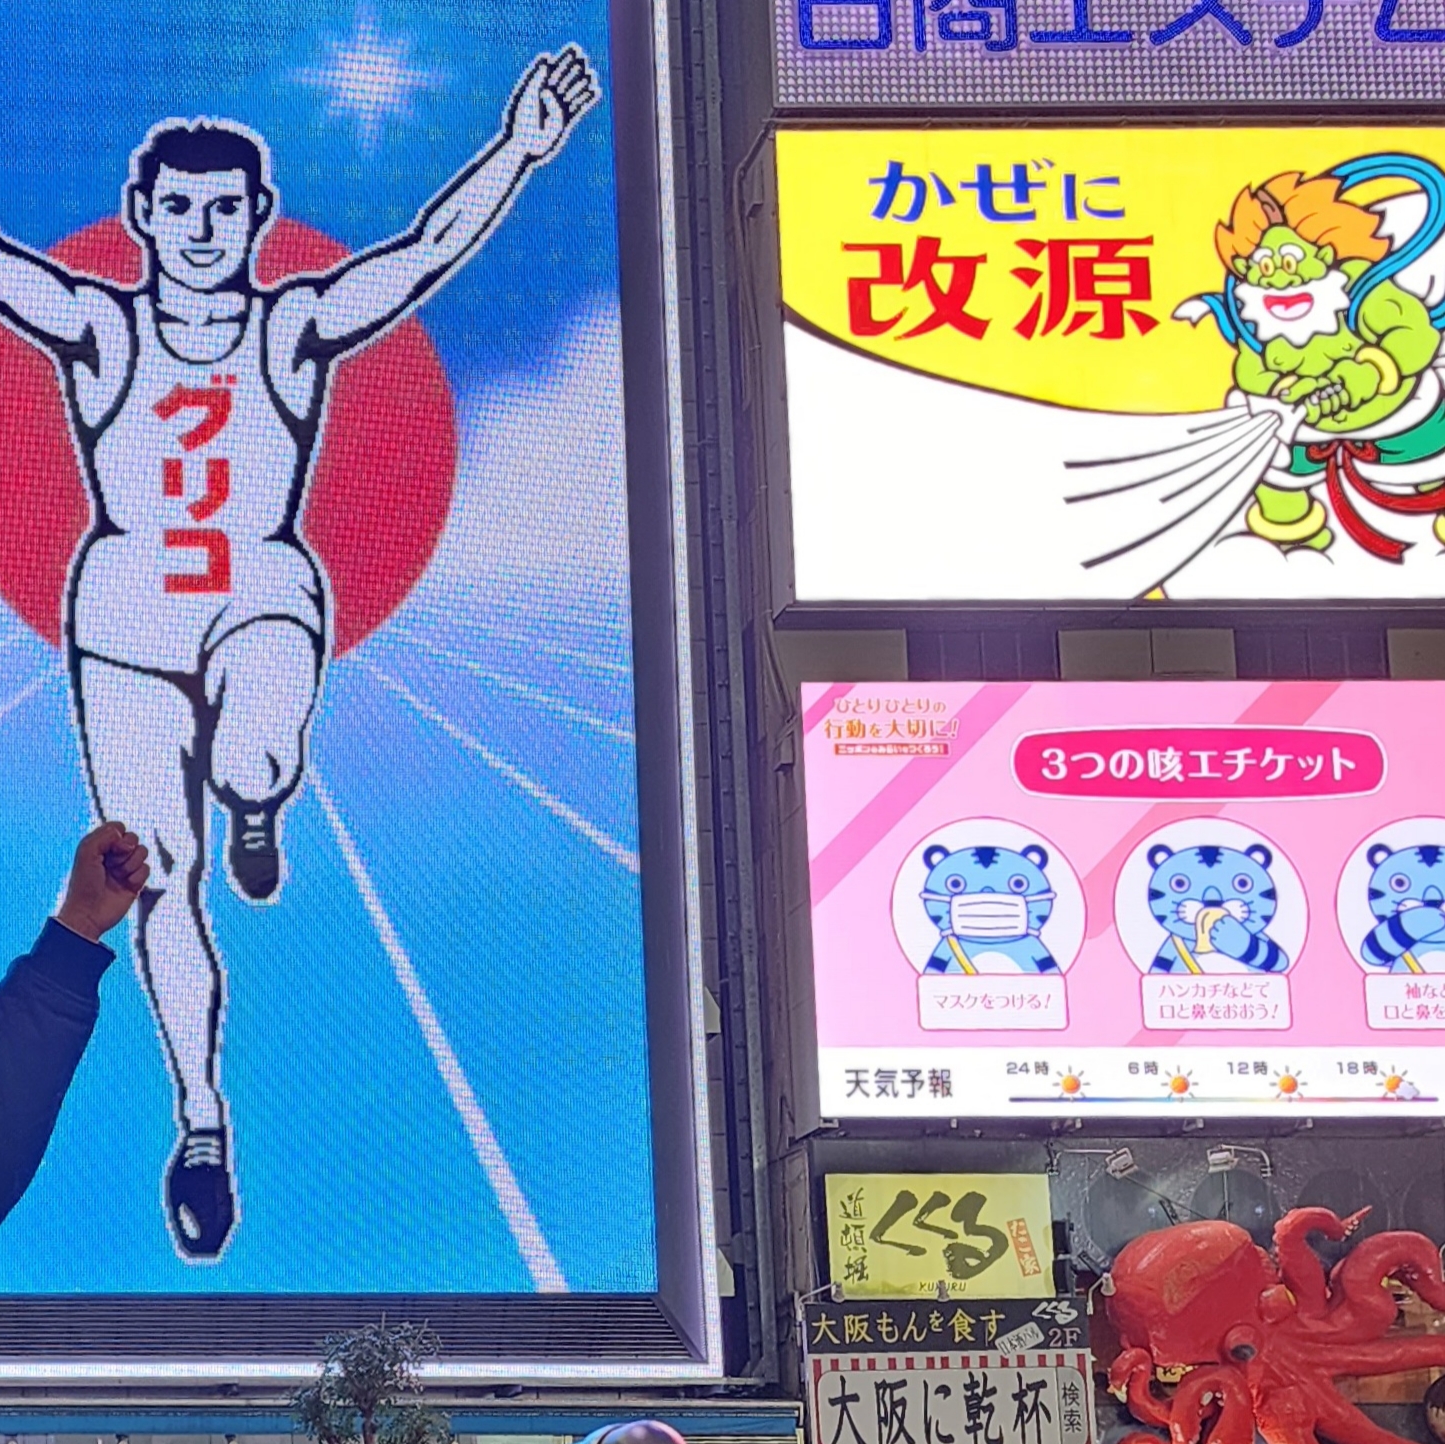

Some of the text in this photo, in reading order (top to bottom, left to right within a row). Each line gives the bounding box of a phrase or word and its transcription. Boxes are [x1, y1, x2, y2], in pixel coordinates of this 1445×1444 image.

[868, 158, 1126, 223] かぜに
[841, 234, 1161, 341] 改源
[154, 373, 237, 594] グリコ
[836, 698, 946, 714] ひとりひとりの
[1041, 746, 1356, 783] 3つの咳エチケット
[933, 993, 1052, 1010] マスクをつける!
[1158, 981, 1271, 999] ハンカチなどで
[1159, 1003, 1279, 1020] 口と鼻をおおう!
[1006, 1061, 1049, 1076] 24時
[1128, 1061, 1158, 1075] 6時
[1227, 1061, 1268, 1075] 12時
[1337, 1060, 1378, 1075] 18時
[845, 1068, 954, 1099] 天気予報
[840, 1187, 870, 1285] 道頓堀
[869, 1189, 1009, 1280] くくる
[811, 1308, 1006, 1346] 大阪もんを食す
[1048, 1327, 1082, 1348] 2F
[1061, 1381, 1082, 1433] 検索
